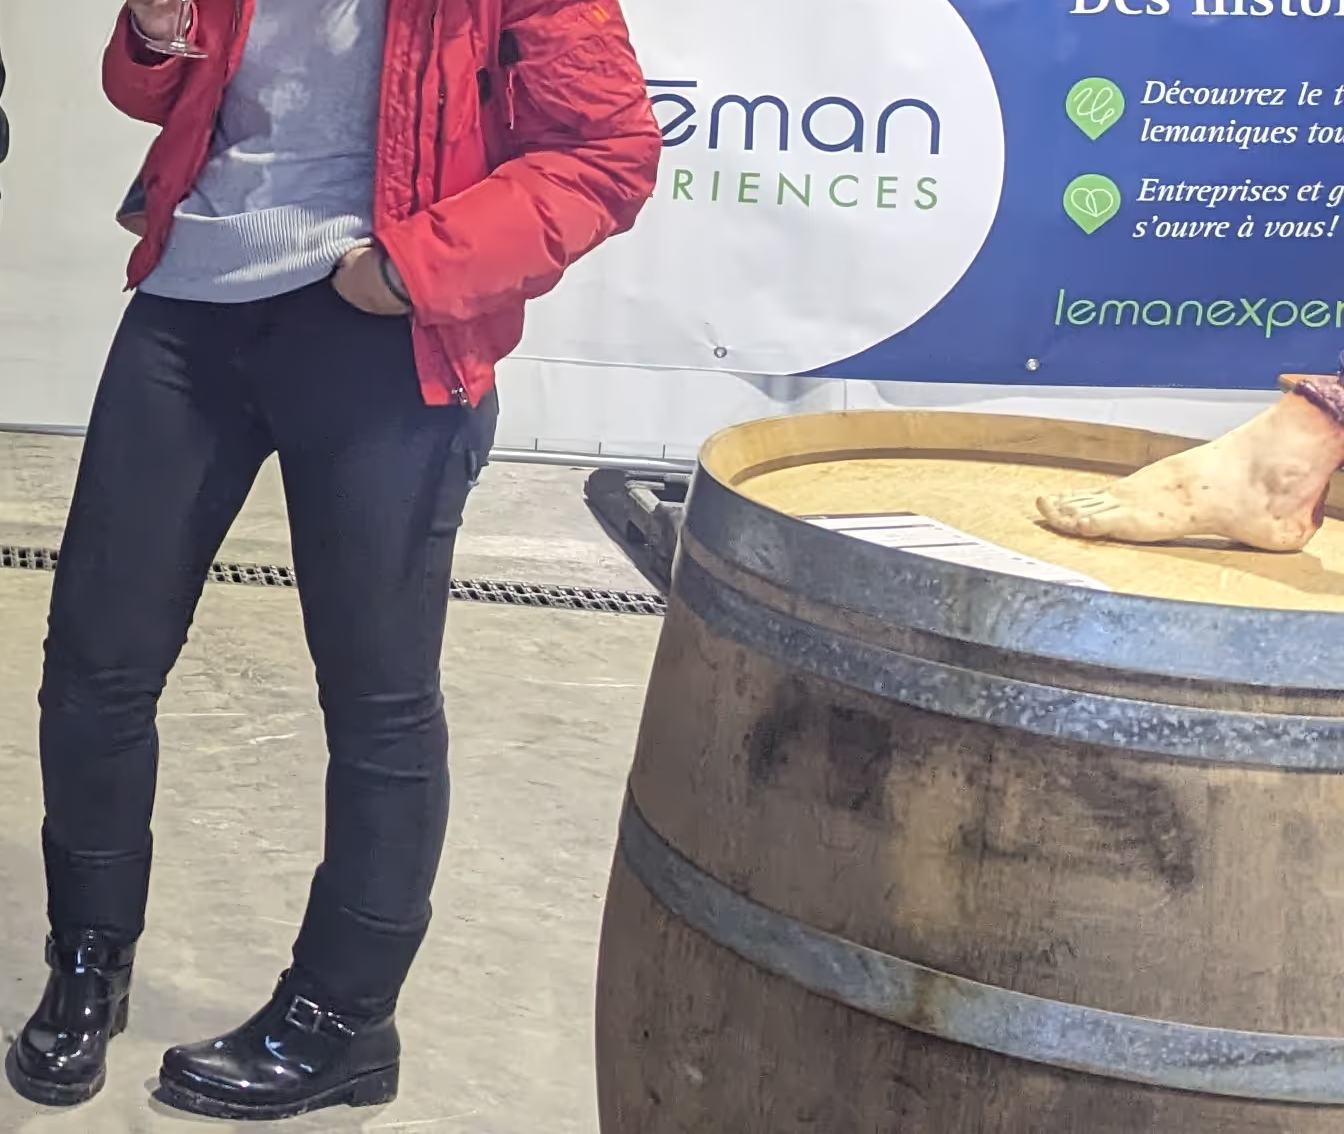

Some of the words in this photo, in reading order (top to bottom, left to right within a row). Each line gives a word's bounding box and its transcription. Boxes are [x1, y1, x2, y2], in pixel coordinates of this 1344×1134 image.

[1140, 80, 1287, 107] Découvrez
[1297, 81, 1323, 107] le
[1140, 118, 1298, 150] lemaniques
[672, 168, 938, 210] RIENCES
[1136, 178, 1290, 208] Entreprises
[1296, 180, 1325, 202] et
[1132, 215, 1230, 239] s’ouvre
[1237, 215, 1256, 239] à
